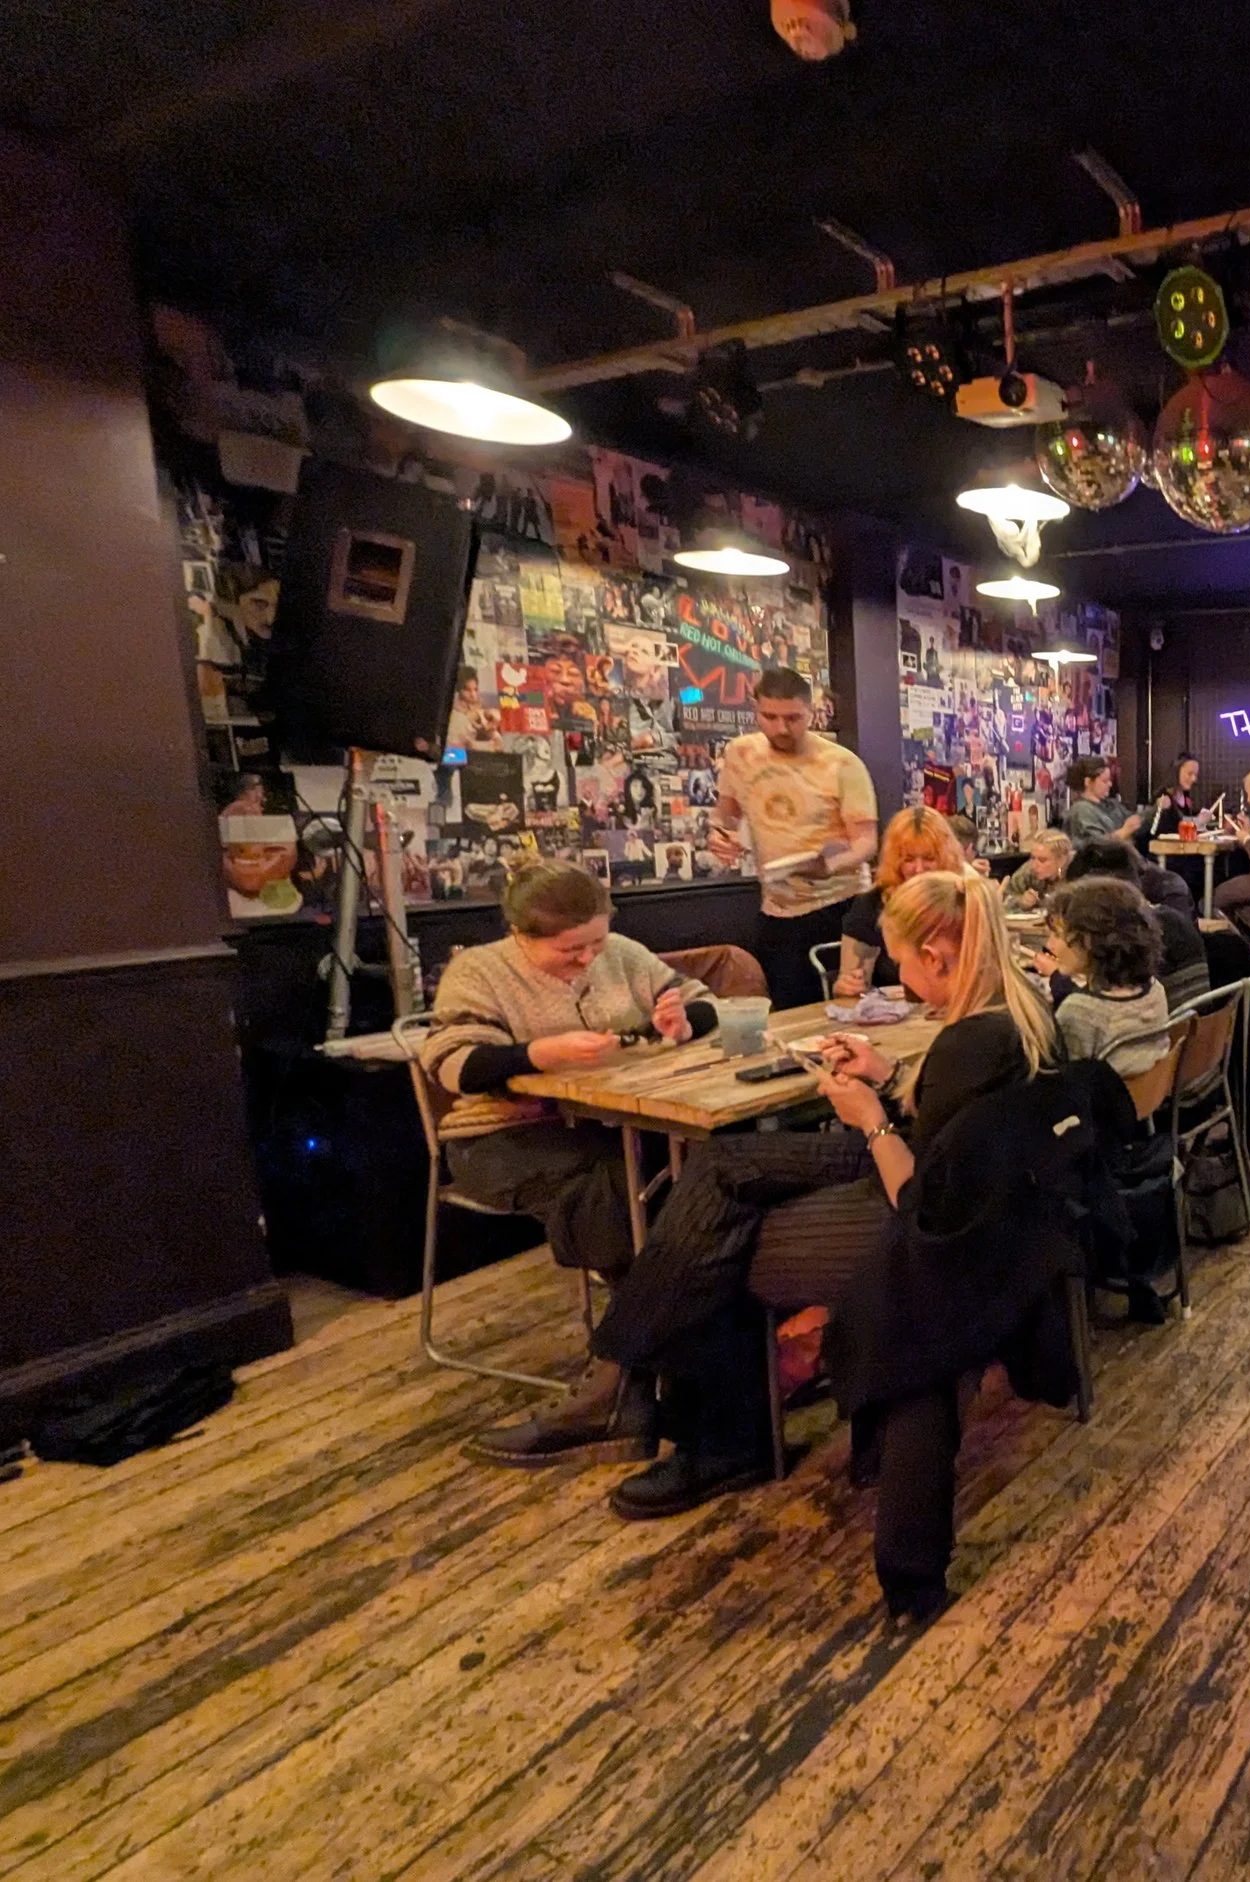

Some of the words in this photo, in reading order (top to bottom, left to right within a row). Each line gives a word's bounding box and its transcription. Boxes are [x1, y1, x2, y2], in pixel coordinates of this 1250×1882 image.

[680, 622, 701, 644] RED
[701, 633, 721, 654] HOT
[682, 706, 699, 722] RED
[737, 710, 756, 724] PEPP
